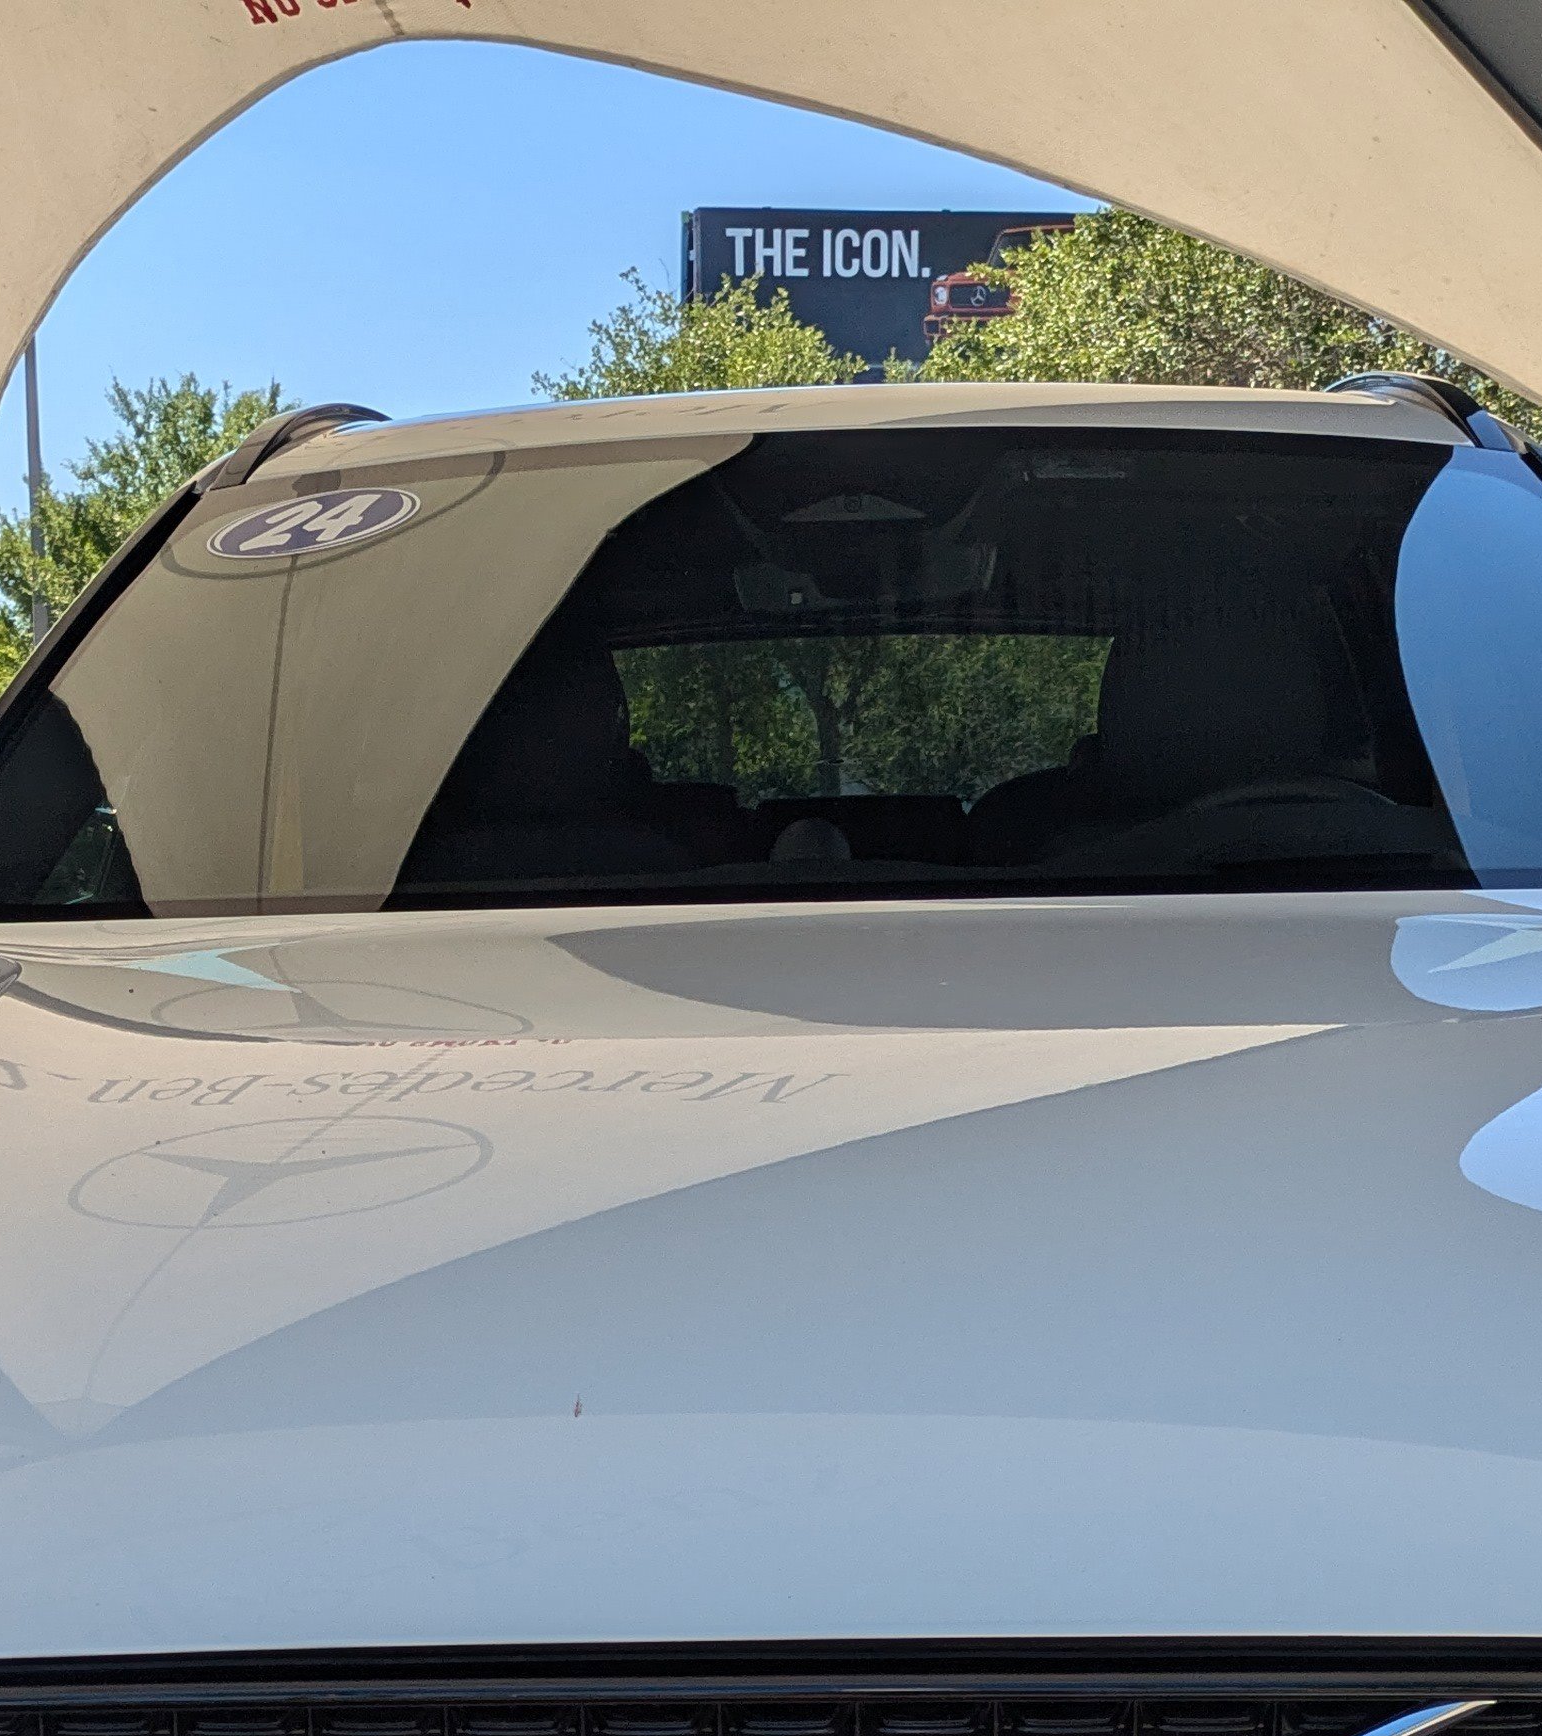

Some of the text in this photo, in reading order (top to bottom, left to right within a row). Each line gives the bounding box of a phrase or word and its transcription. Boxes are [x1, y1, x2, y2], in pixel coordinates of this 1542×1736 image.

[725, 228, 931, 278] THE ICON.
[239, 494, 383, 552] 24
